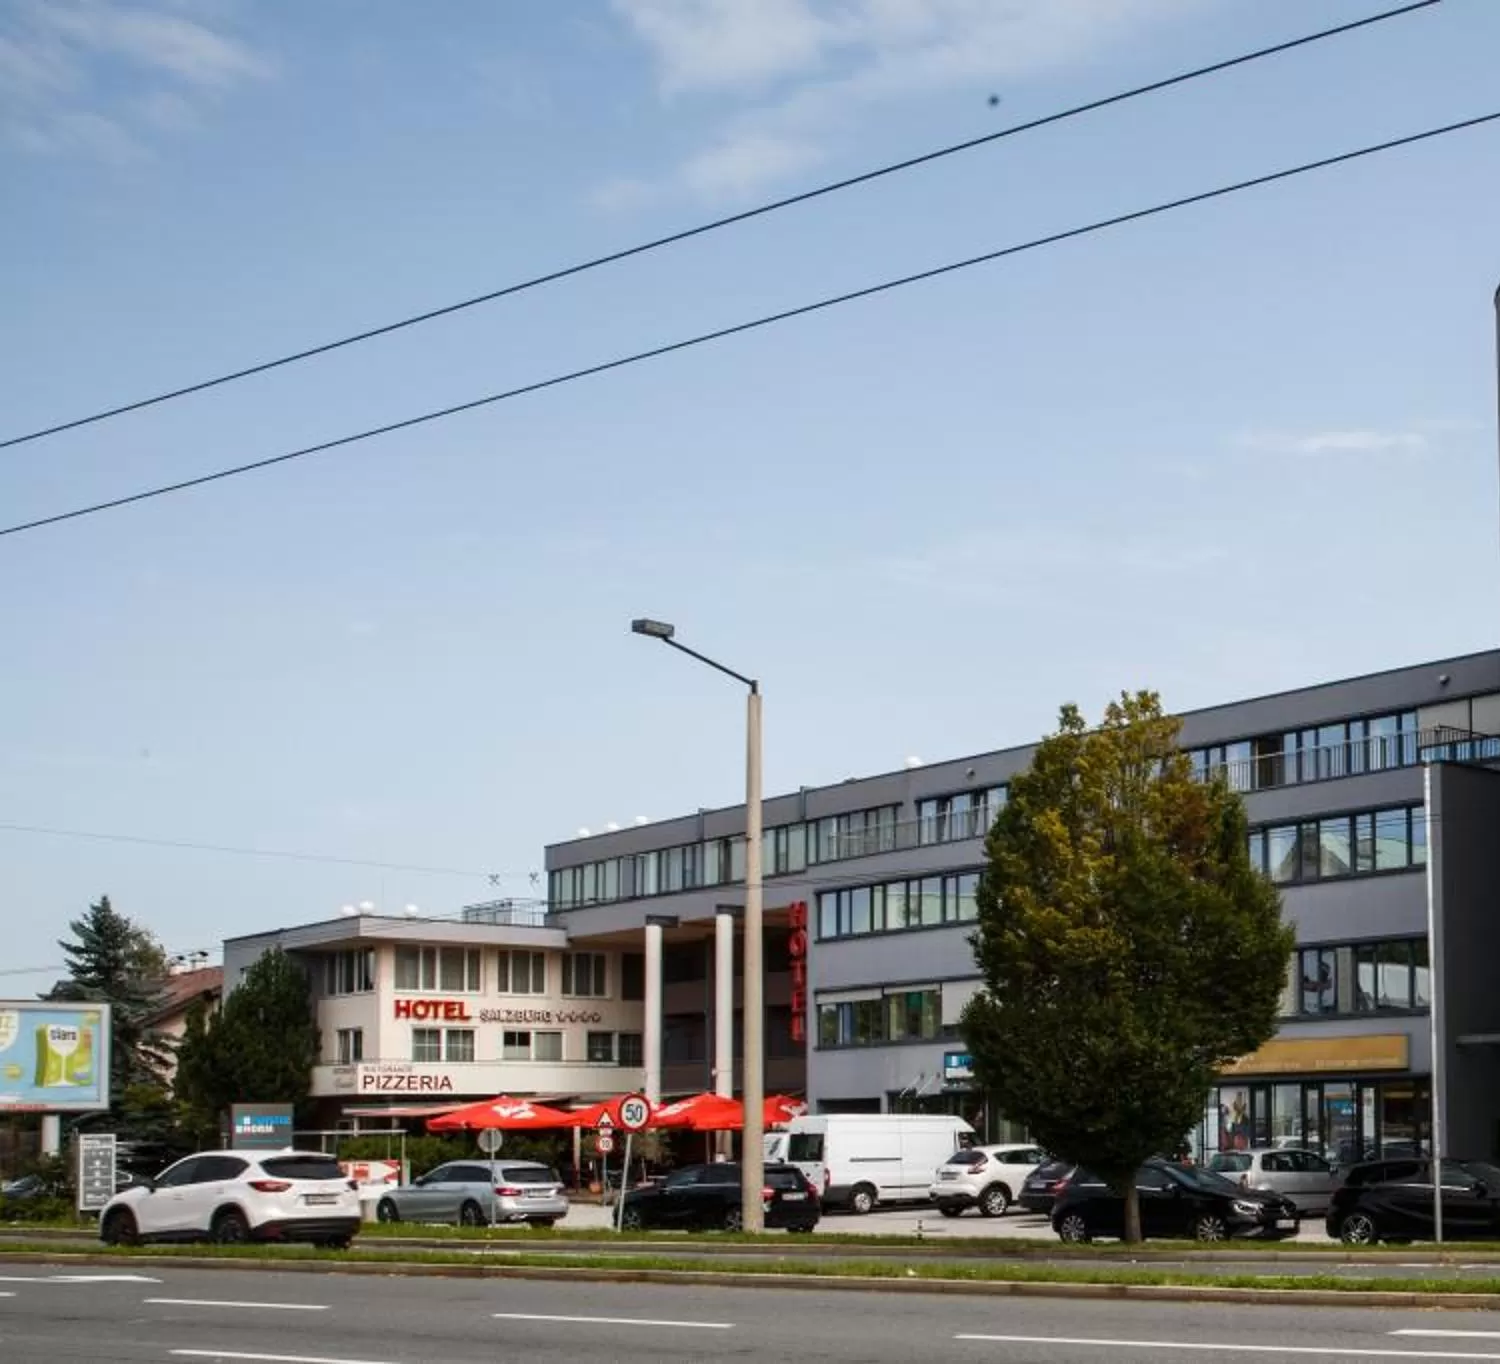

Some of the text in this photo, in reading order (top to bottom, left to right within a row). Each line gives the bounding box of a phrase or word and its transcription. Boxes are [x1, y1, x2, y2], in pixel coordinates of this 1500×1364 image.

[789, 900, 807, 1042] HOTEL
[394, 1000, 551, 1024] HOTEL SALZBURG
[363, 1075, 453, 1091] PIZZERIA
[625, 1103, 643, 1123] 50
